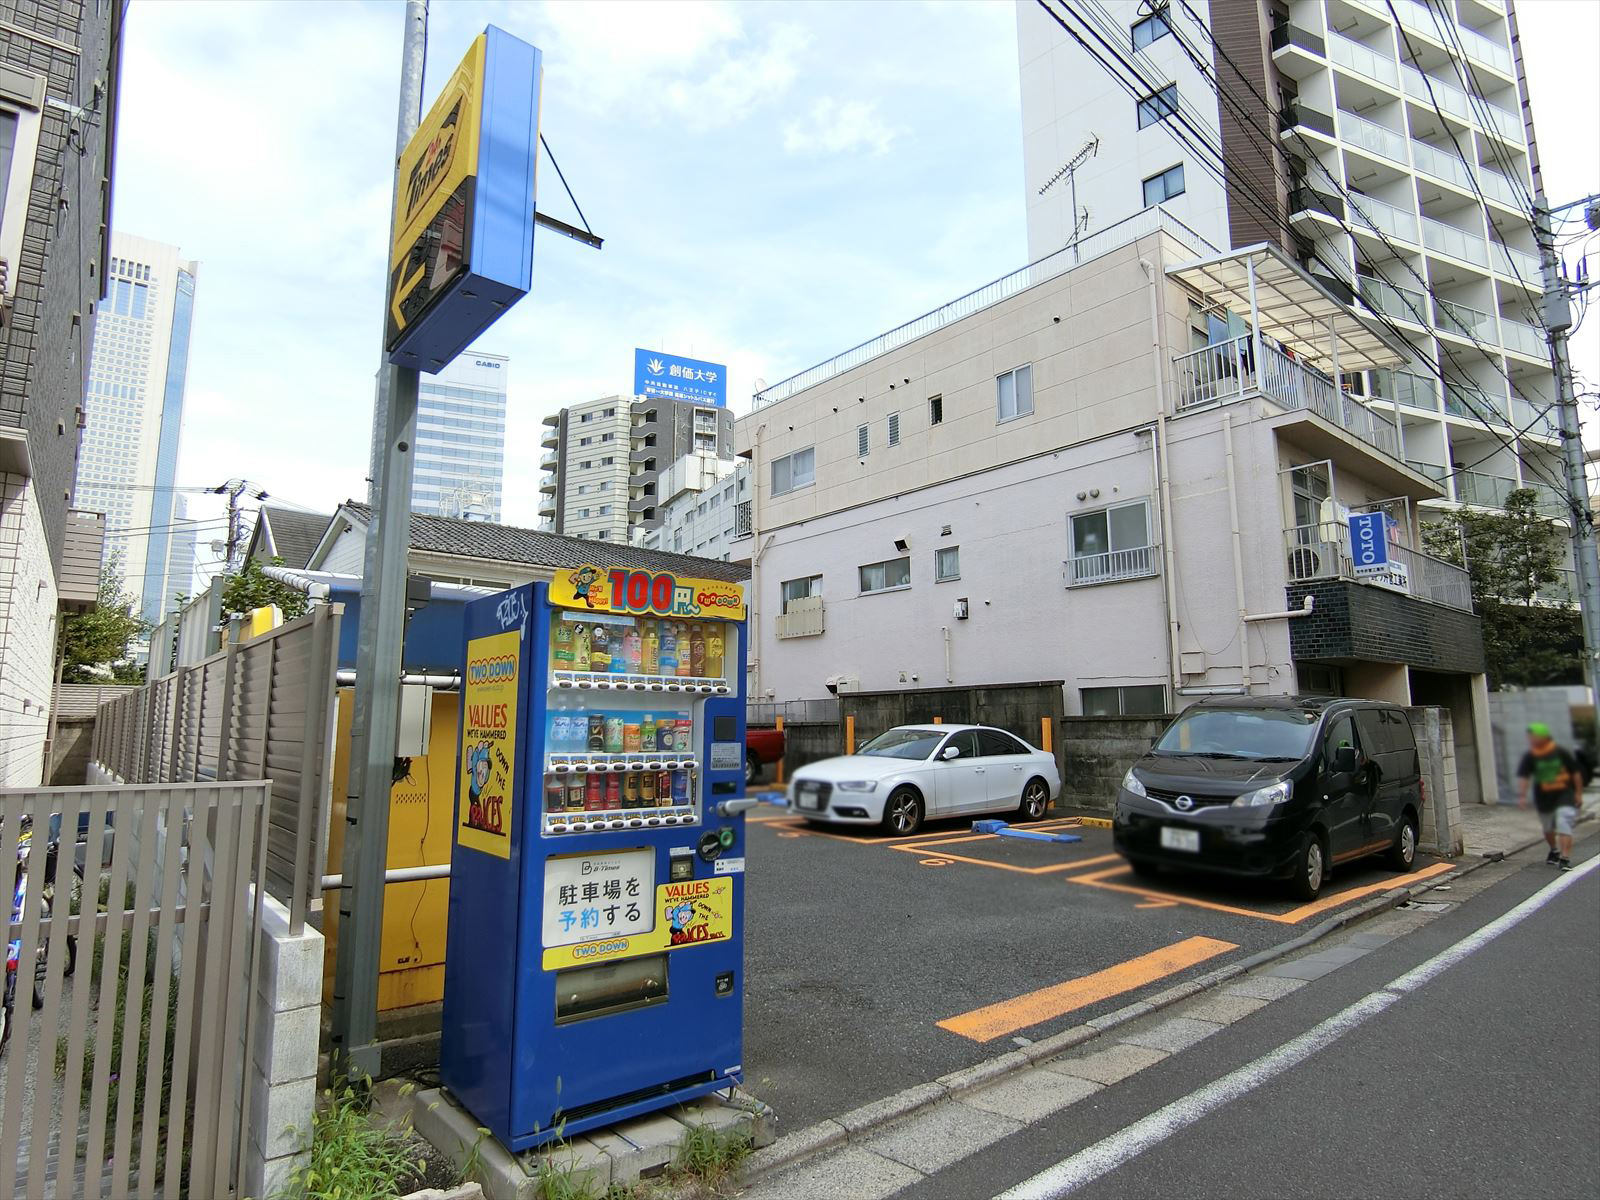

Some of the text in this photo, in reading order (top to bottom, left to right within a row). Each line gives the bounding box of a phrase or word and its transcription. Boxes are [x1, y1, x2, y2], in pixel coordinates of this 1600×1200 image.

[405, 131, 454, 221] Times
[475, 360, 501, 369] CASIO
[669, 364, 718, 384] 創価大学
[1359, 516, 1375, 564] TOTO
[470, 660, 515, 681] TWO DOWN
[468, 703, 508, 729] VALUES
[480, 729, 507, 740] HAMMERED
[495, 747, 510, 774] DOWN
[495, 771, 506, 790] THE
[558, 877, 640, 906] 駐車場を
[665, 882, 710, 897] VALUES
[681, 893, 710, 901] HAMMERED
[698, 902, 712, 912] DOWN
[698, 912, 709, 921] THE
[558, 902, 640, 933] 予約する
[575, 940, 627, 957] TWO DOWN
